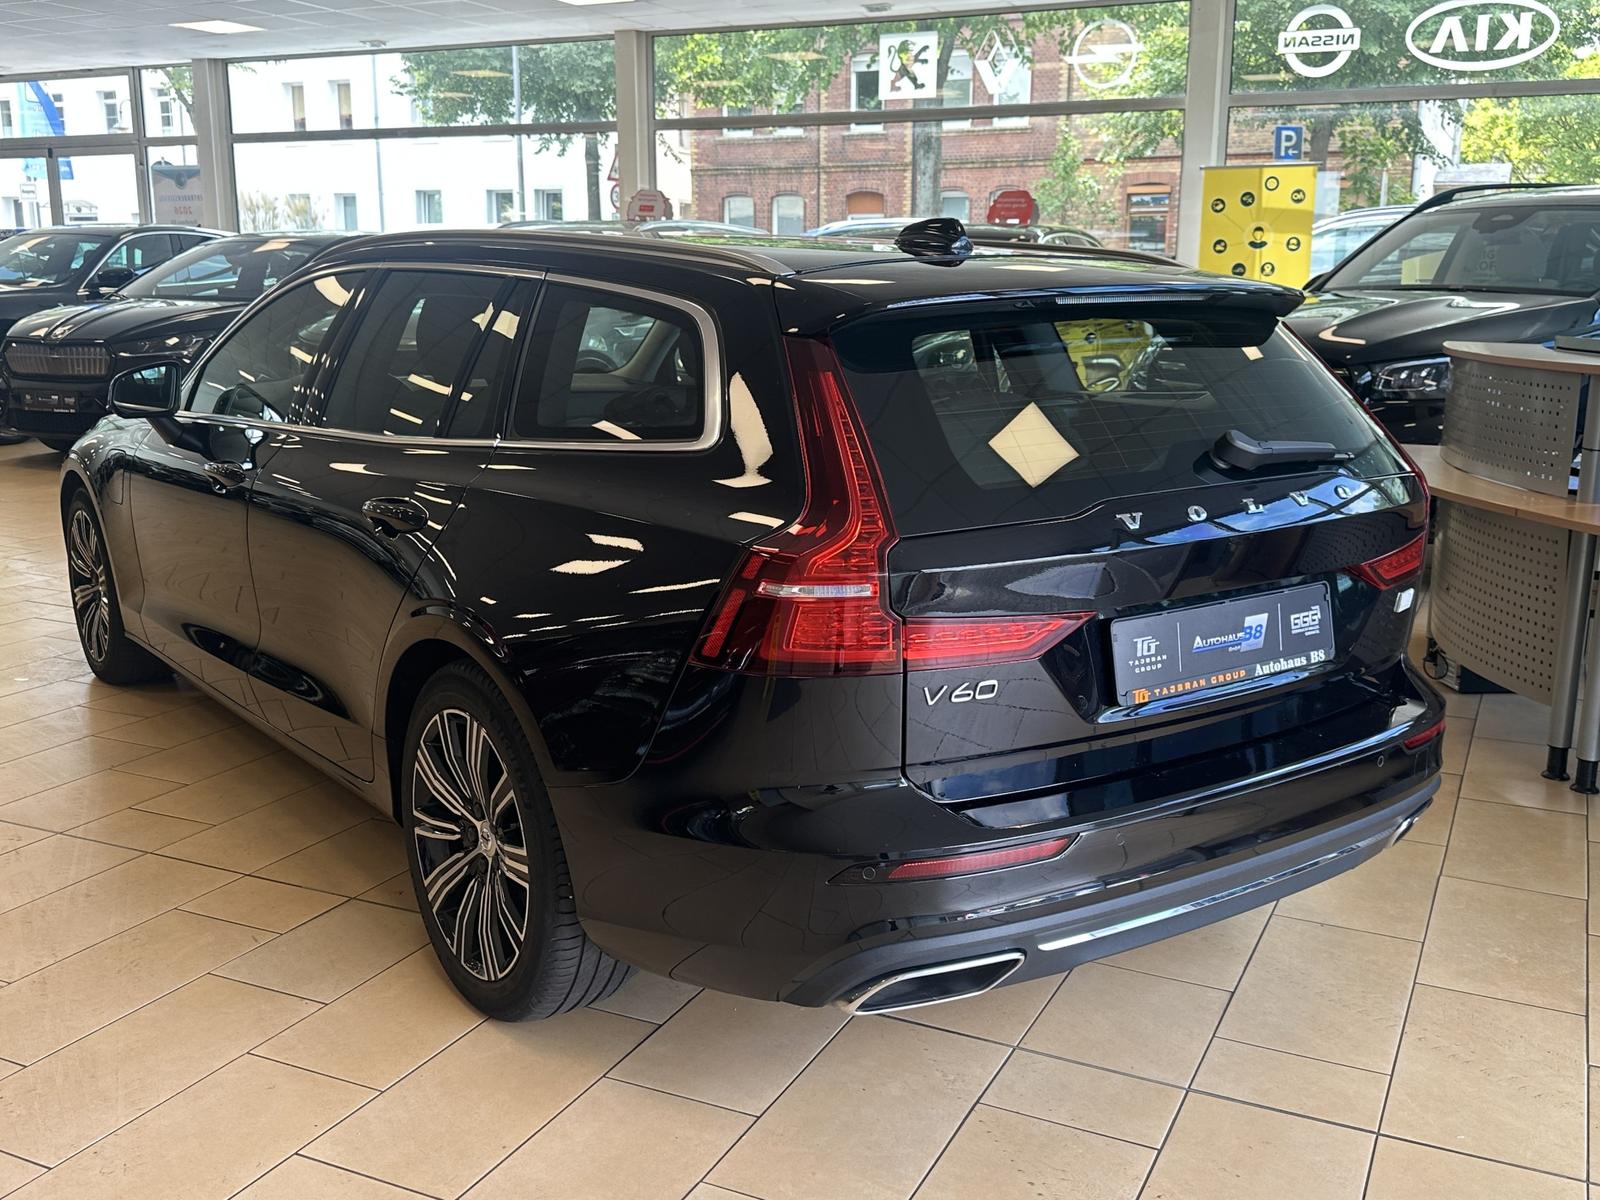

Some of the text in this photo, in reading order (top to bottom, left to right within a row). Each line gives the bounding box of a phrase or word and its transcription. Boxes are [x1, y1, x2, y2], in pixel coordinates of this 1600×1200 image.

[1281, 129, 1298, 156] P
[1115, 484, 1351, 530] VOLVO
[1135, 663, 1162, 674] GROUP
[1255, 649, 1326, 677] Autohaus B8
[924, 680, 998, 705] V60
[1154, 679, 1206, 696] TAJBRAN
[1211, 670, 1247, 684] GROUP
